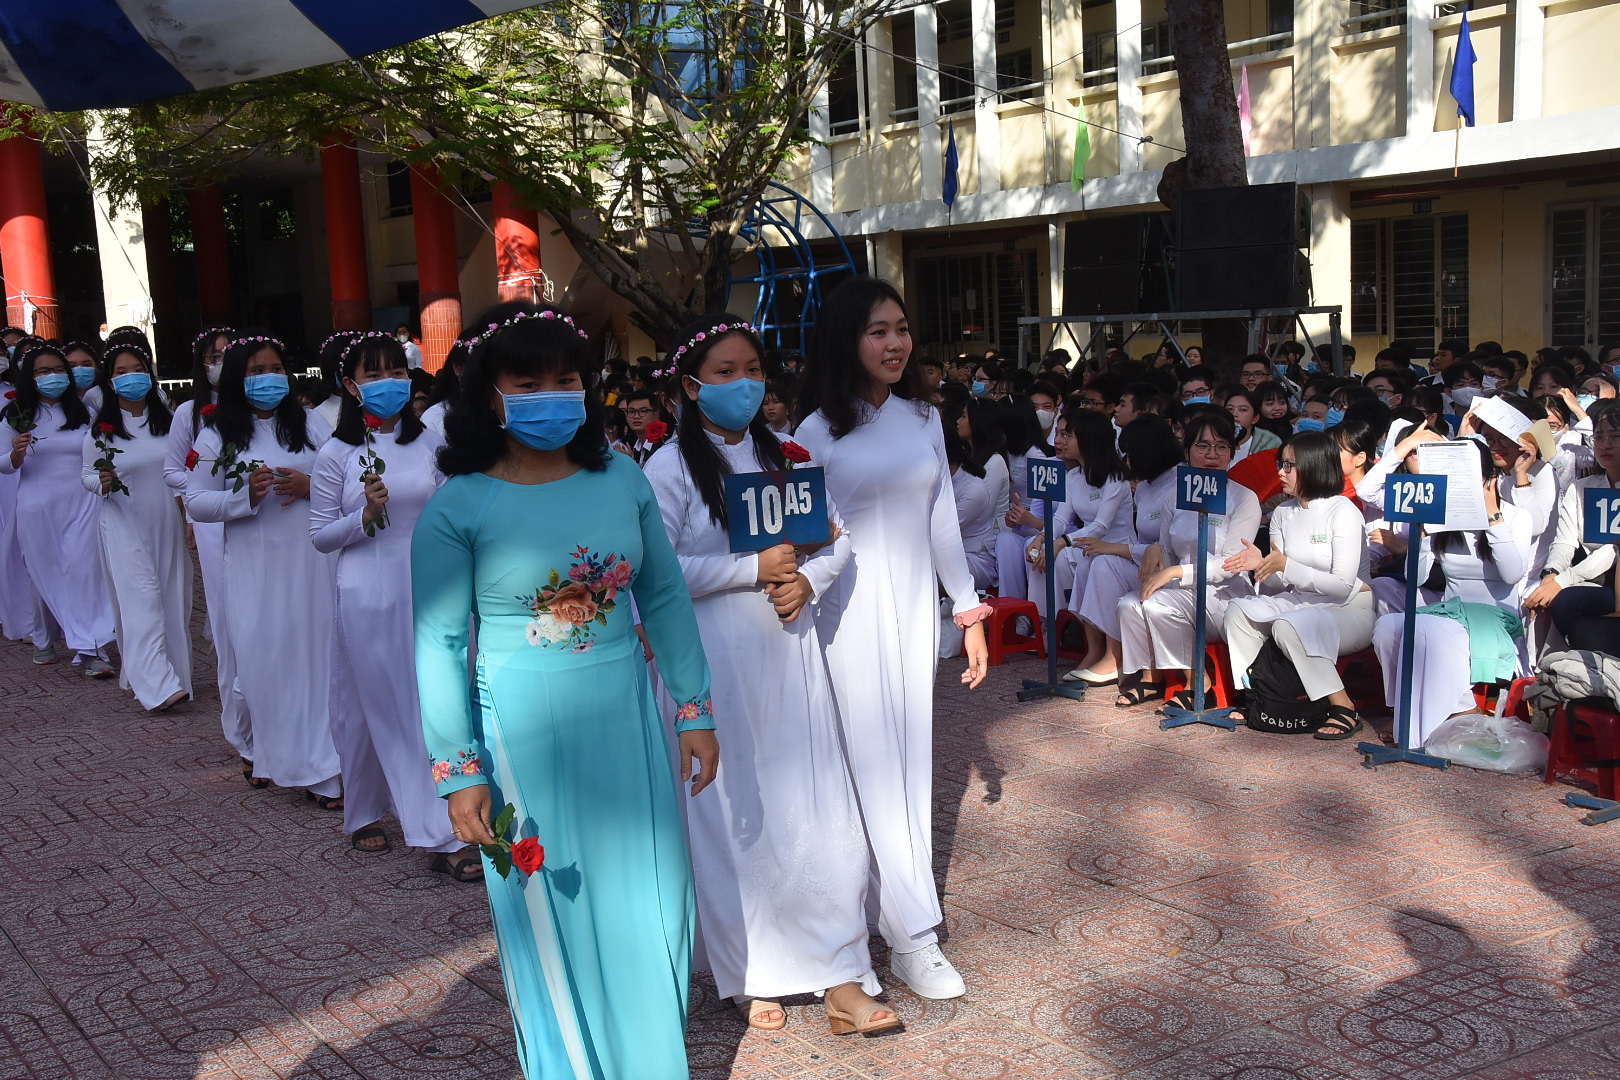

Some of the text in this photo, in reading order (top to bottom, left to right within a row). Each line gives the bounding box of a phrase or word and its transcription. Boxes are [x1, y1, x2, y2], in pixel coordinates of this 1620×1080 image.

[1031, 464, 1058, 492] 12A5
[1184, 473, 1218, 504] 12A4
[741, 481, 813, 536] 10A5
[1392, 481, 1435, 514] 12A3
[1260, 711, 1308, 729] Rabbit
